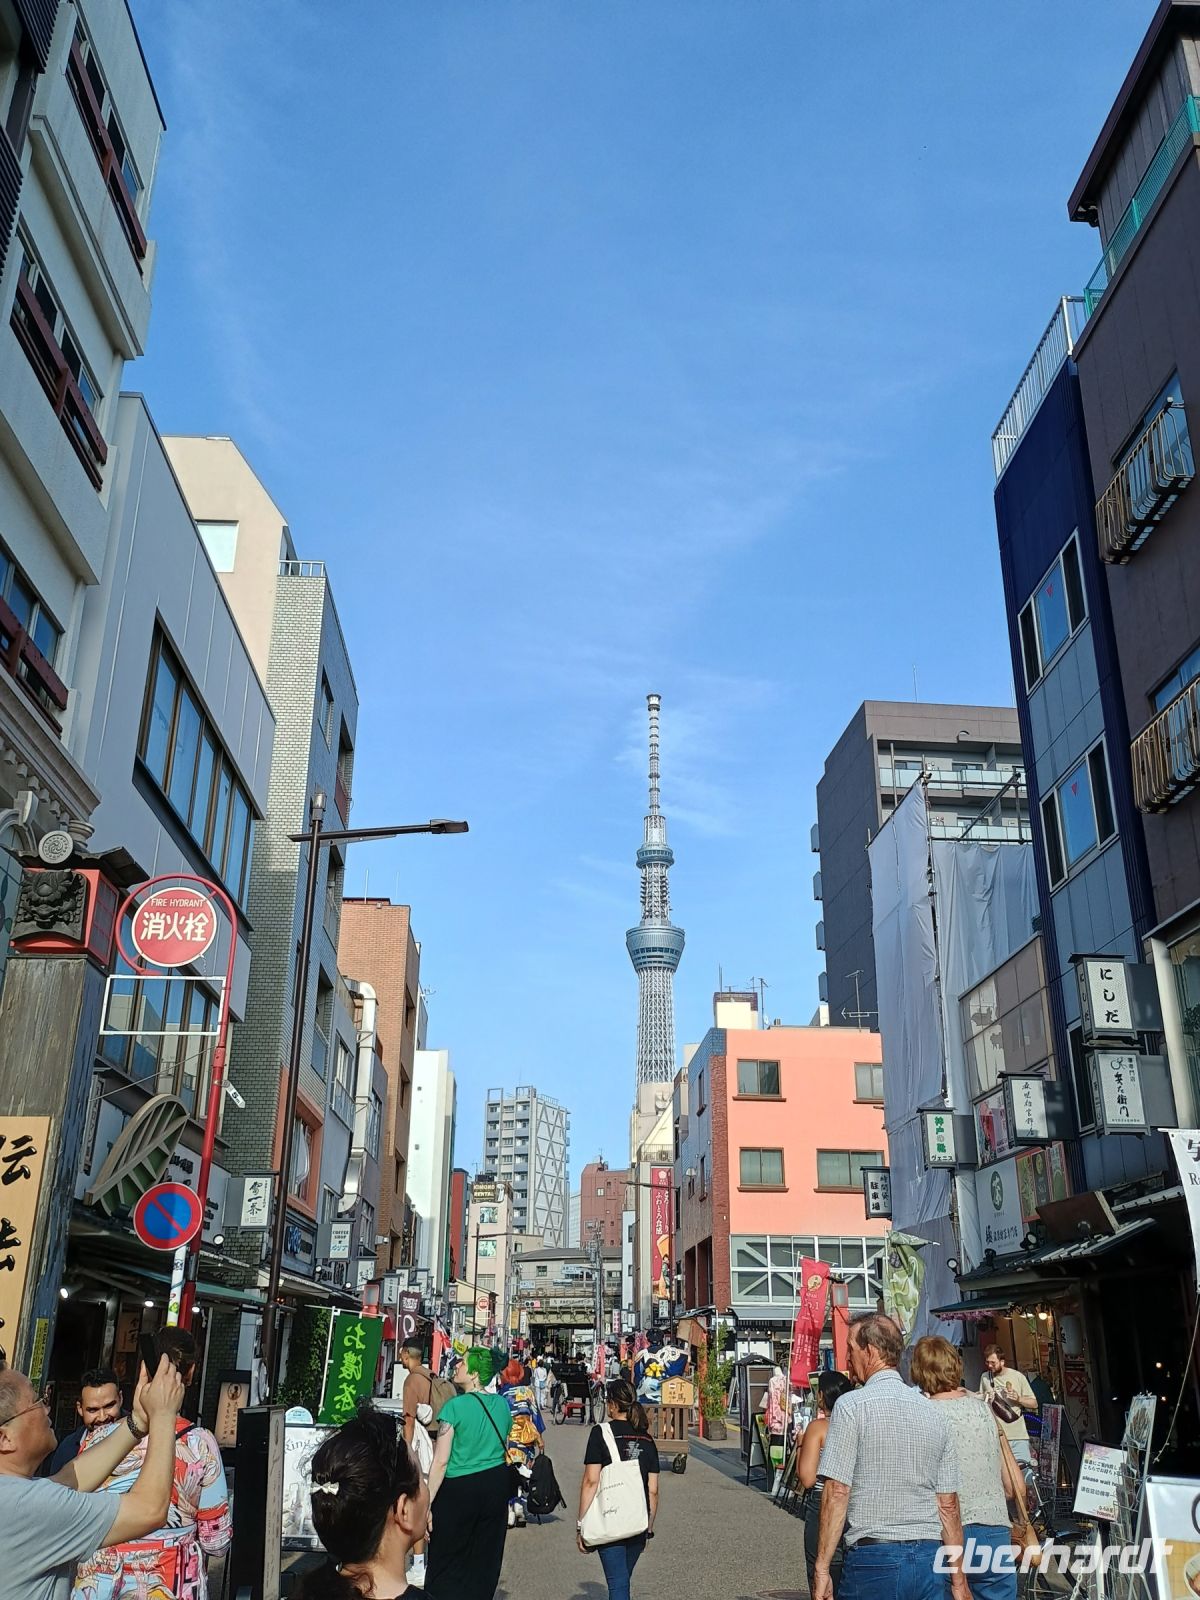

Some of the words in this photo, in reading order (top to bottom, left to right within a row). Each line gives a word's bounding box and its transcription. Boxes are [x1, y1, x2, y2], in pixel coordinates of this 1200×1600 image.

[151, 898, 168, 907] FIRE
[169, 898, 204, 908] HYDRANT
[140, 911, 209, 942] 消火栓
[1100, 968, 1120, 1023] にしだ
[1188, 1172, 1200, 1186] R
[870, 1181, 881, 1211] 駐車場
